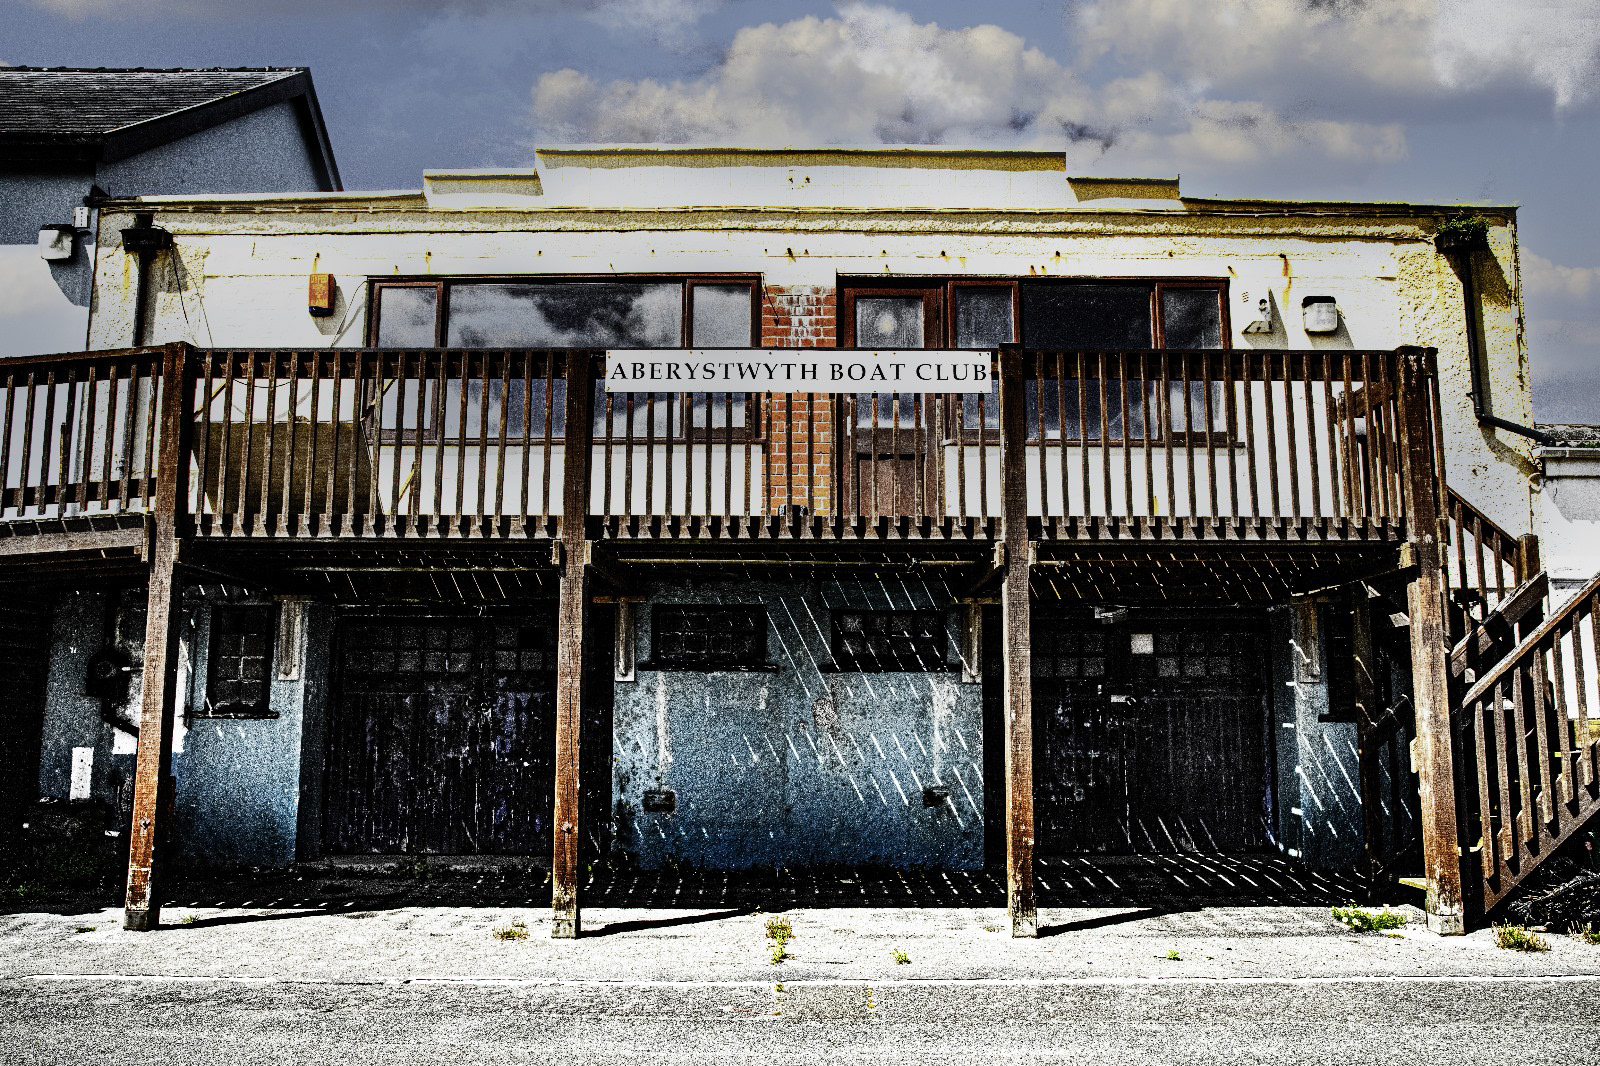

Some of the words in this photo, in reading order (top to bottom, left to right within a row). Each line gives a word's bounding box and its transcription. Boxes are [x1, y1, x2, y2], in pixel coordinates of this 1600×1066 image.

[610, 362, 818, 381] ABERYSTWYTH
[830, 363, 906, 381] BOAT
[915, 363, 987, 381] CLUB
